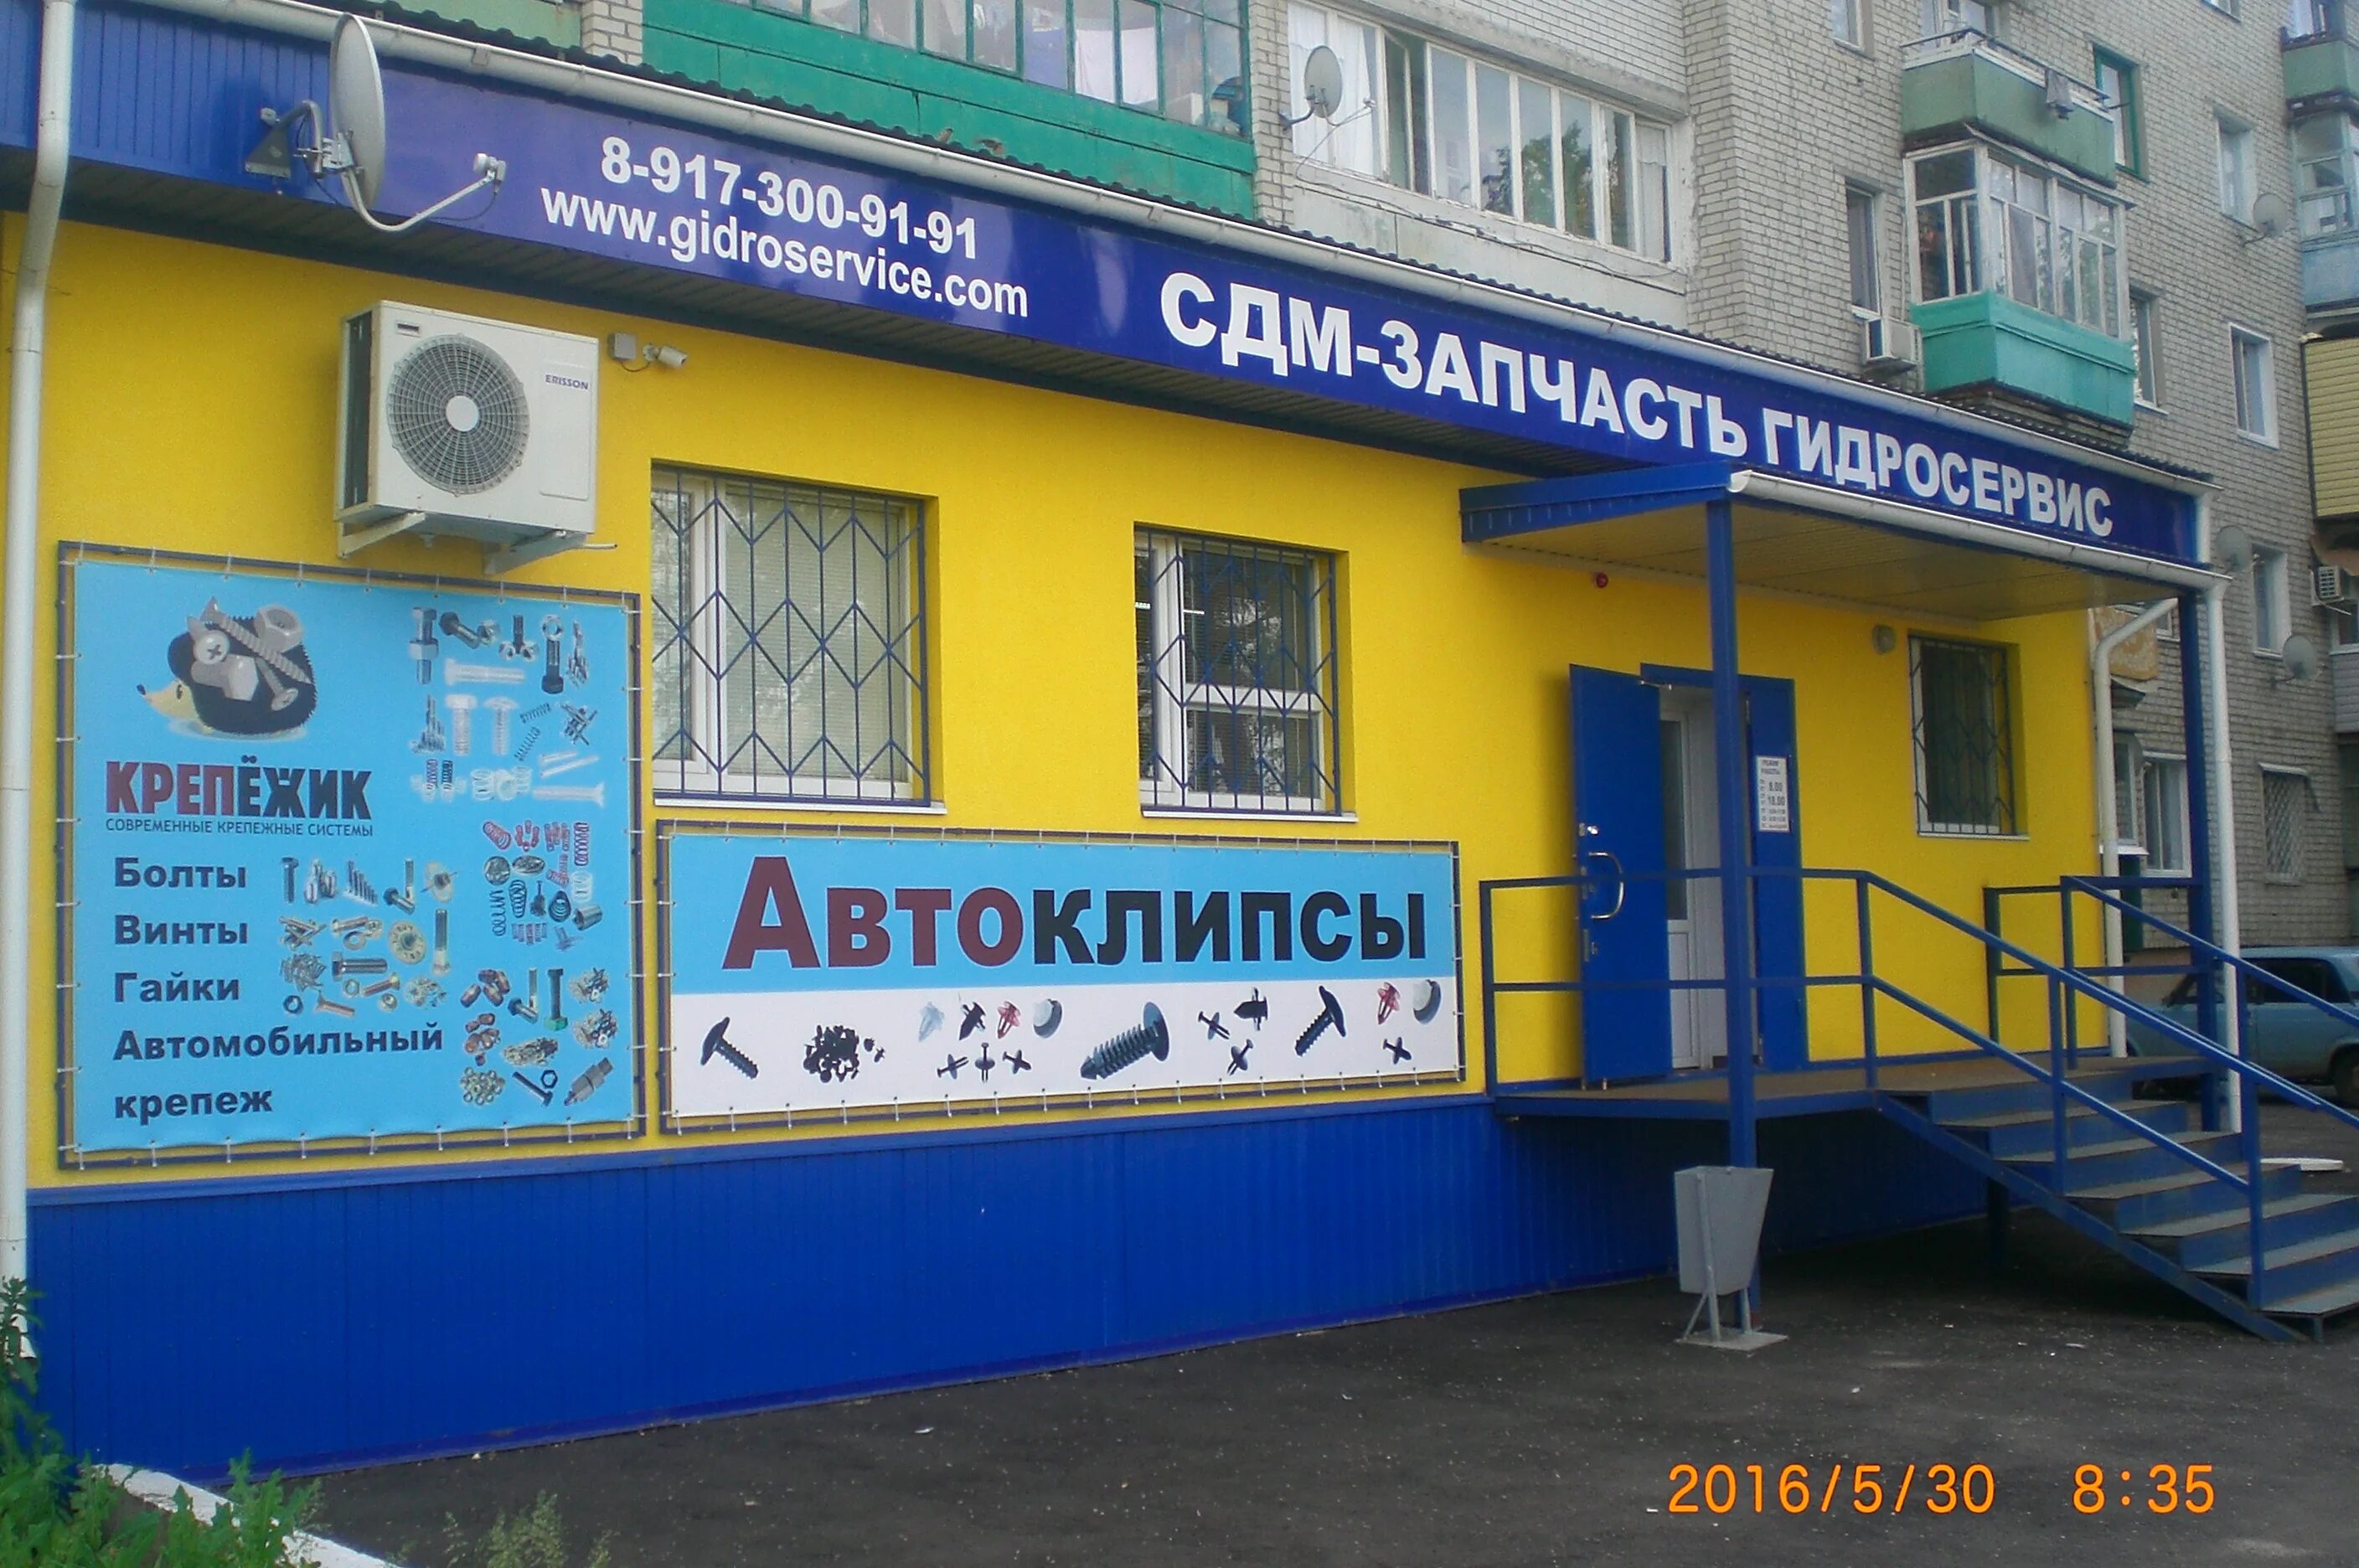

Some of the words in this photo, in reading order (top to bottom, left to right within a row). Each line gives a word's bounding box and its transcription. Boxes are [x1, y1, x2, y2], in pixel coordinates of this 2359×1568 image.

[601, 136, 976, 260] 8-917-300-91-91
[540, 187, 1028, 317] www.gidroservice.com
[545, 374, 589, 390] ERISSON
[1160, 272, 1748, 457] СДМ-ЗАПЧАСТЬ
[1763, 407, 2114, 537] ГИДРОСЕРВИС
[106, 755, 373, 820] КРЕПЁЖИК
[106, 818, 213, 833] СОВРЕМЕННЫЕ
[217, 820, 304, 836] КРЕПЕЖНЫЕ
[307, 823, 374, 838] СИСТЕМЫ
[114, 857, 246, 889] Болты
[114, 914, 248, 946] Винты
[721, 856, 1427, 970] Автоклипсы
[114, 971, 240, 1003] Гайки
[112, 1021, 443, 1061] Автомобильный
[114, 1090, 273, 1127] крепеж
